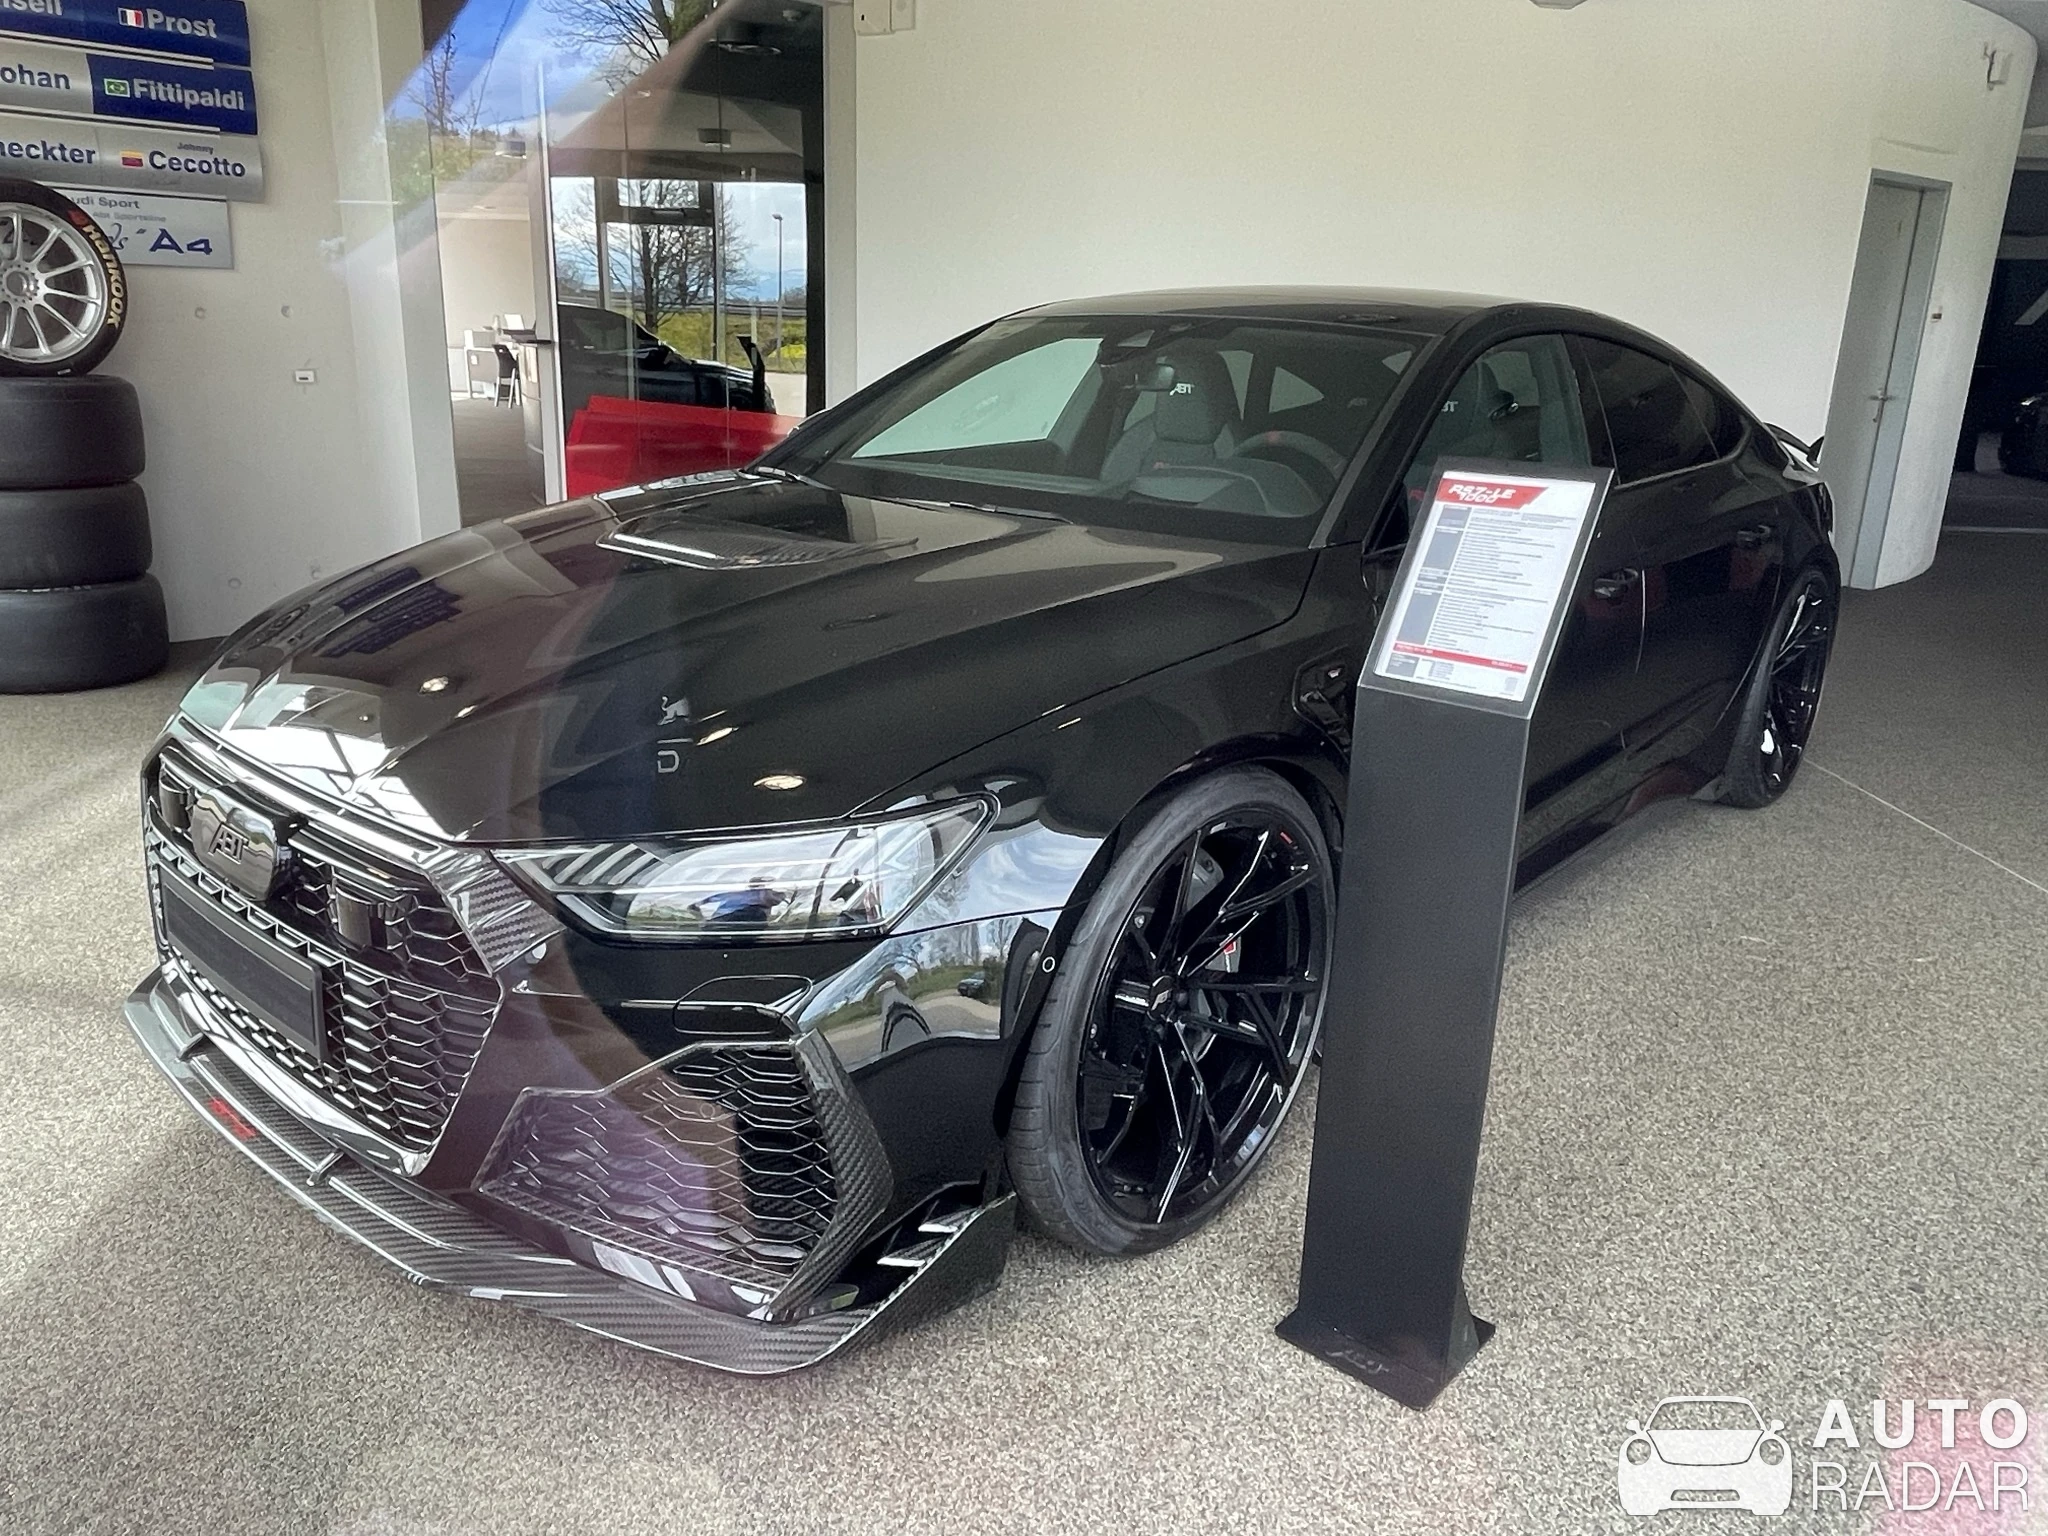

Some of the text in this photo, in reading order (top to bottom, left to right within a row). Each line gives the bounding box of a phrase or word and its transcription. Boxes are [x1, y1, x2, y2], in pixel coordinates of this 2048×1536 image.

[146, 8, 217, 39] Prost
[133, 78, 245, 111] Fittipaldi
[148, 150, 246, 177] Cecotto
[71, 196, 140, 209] udi Sport
[149, 228, 213, 255] A4
[1169, 382, 1196, 396] ABT
[207, 822, 249, 865] ABT
